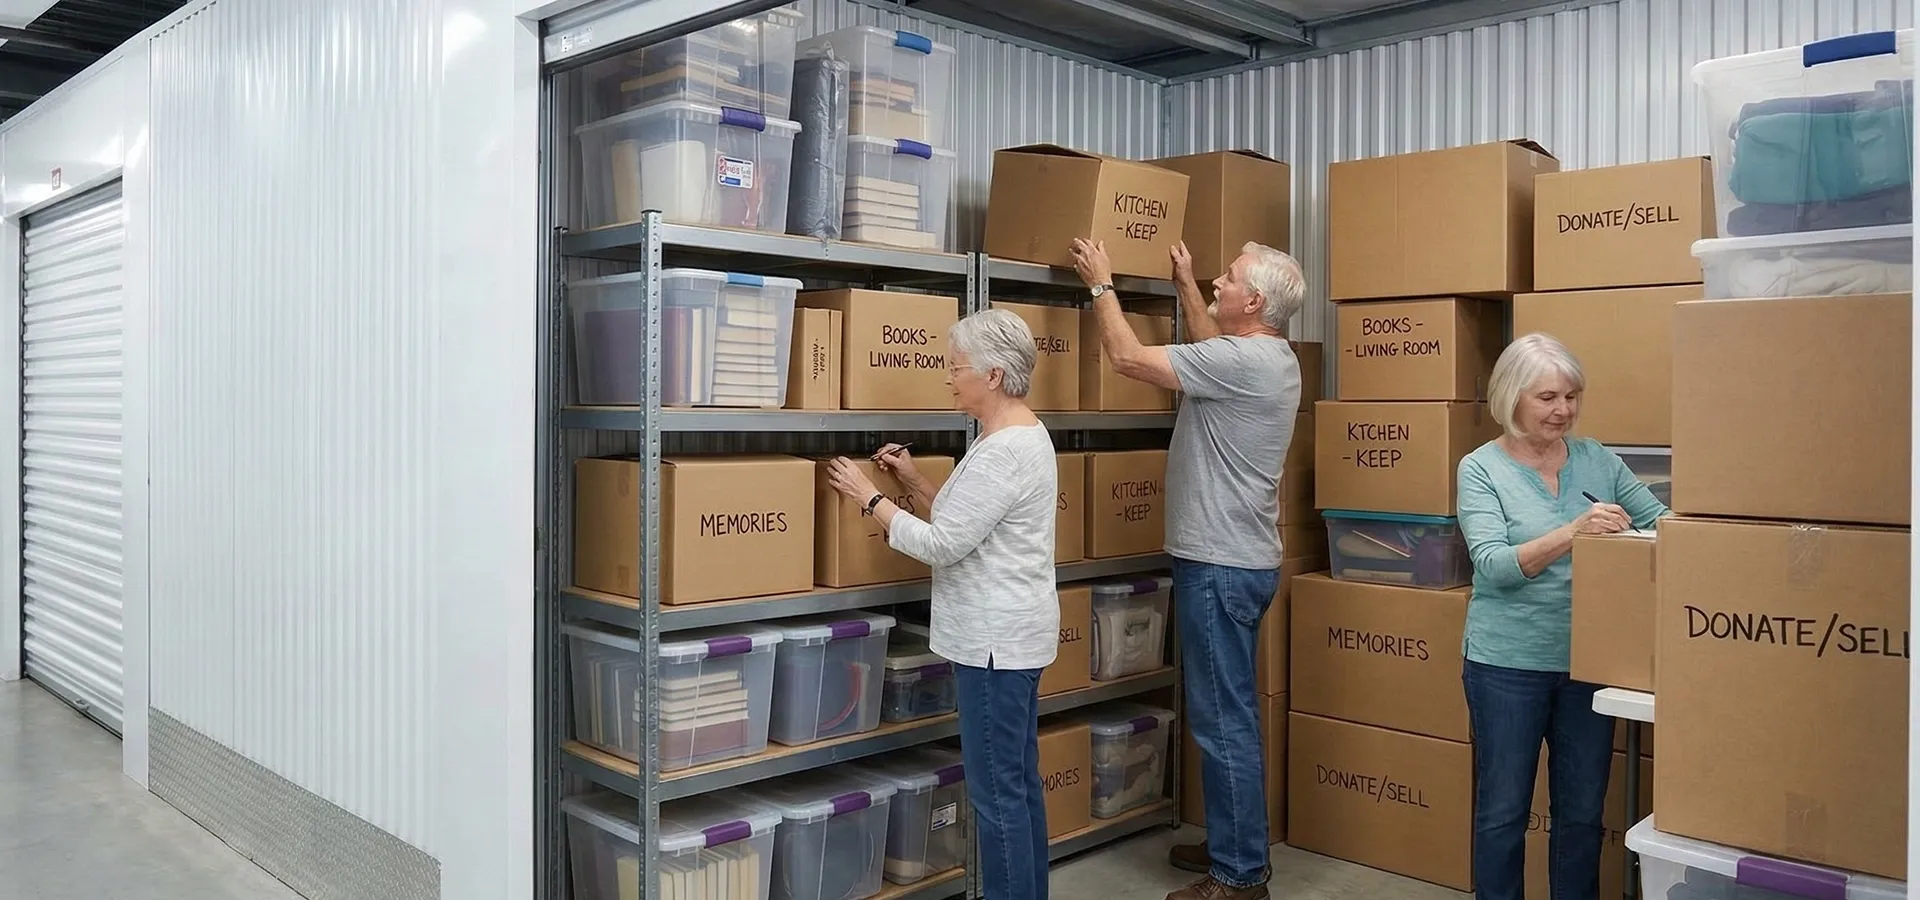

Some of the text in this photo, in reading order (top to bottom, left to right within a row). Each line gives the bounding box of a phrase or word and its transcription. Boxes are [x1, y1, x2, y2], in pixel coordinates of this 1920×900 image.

[1113, 191, 1169, 220] KITCHEN
[1557, 202, 1680, 234] DONATE/SELL
[869, 350, 946, 370] LIVING ROOM
[1403, 339, 1441, 356] ROOM
[1347, 421, 1410, 441] KTCHEN
[700, 512, 788, 538] MEMORIES
[1327, 626, 1430, 661] MEMORIES
[1316, 764, 1430, 809] DONATE/SELL
